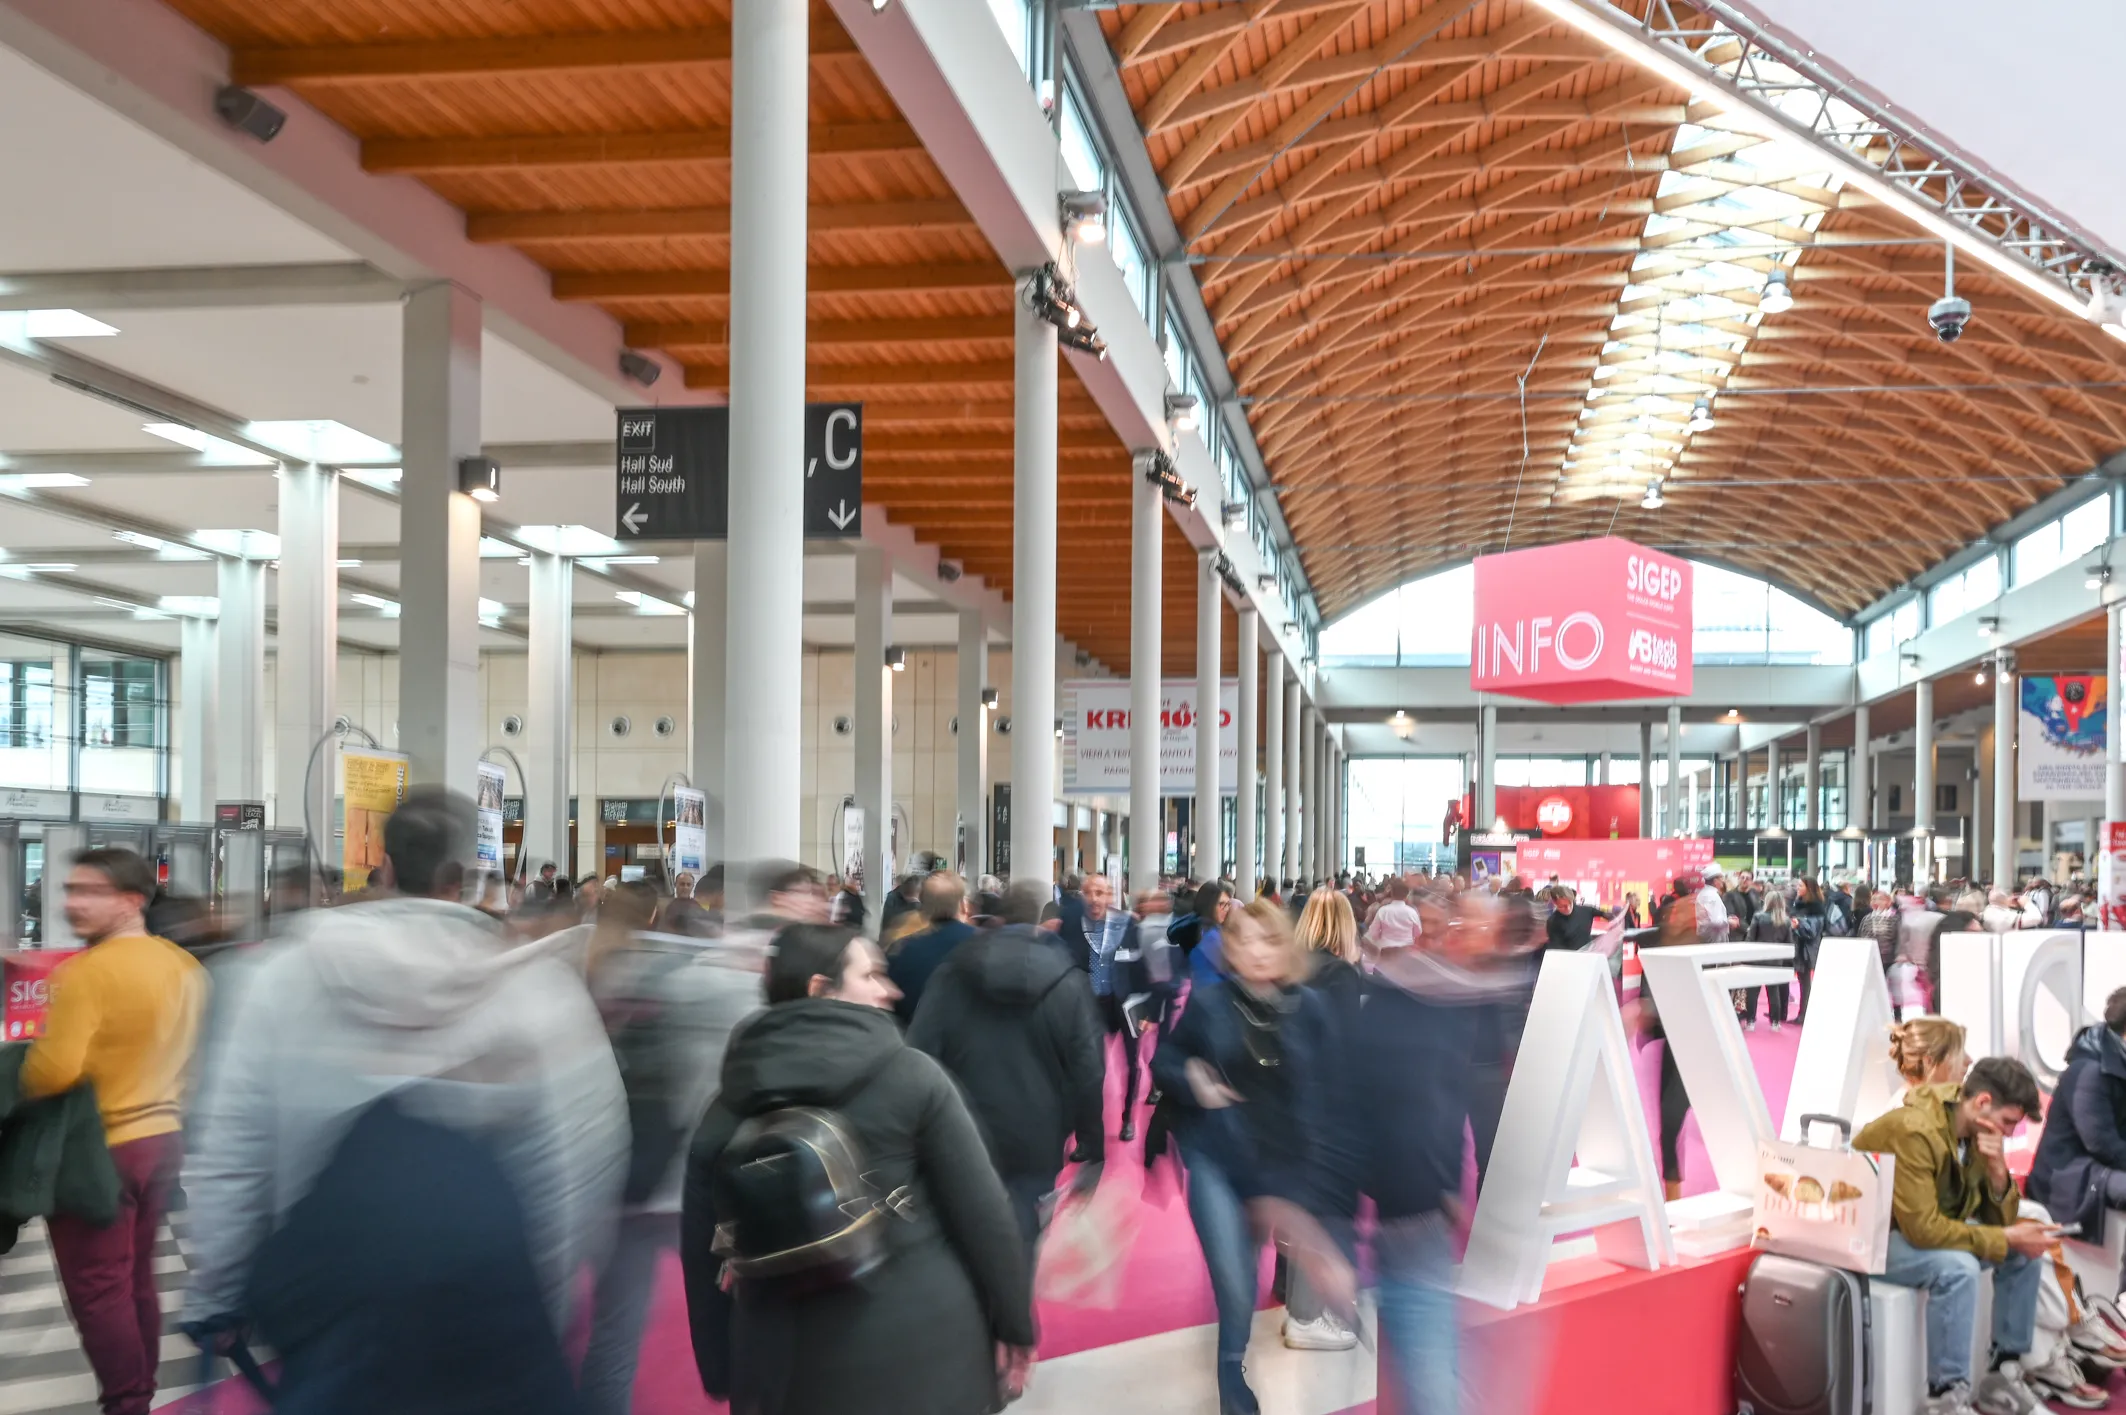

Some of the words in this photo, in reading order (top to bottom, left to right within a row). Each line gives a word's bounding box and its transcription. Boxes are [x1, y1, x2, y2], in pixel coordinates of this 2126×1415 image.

[623, 421, 654, 437] EXIT
[621, 455, 646, 474] Hall
[648, 454, 674, 474] Sud
[621, 476, 646, 495] Hall
[648, 475, 686, 495] South
[1626, 554, 1682, 602] SIGEP
[1478, 611, 1604, 679] INFO
